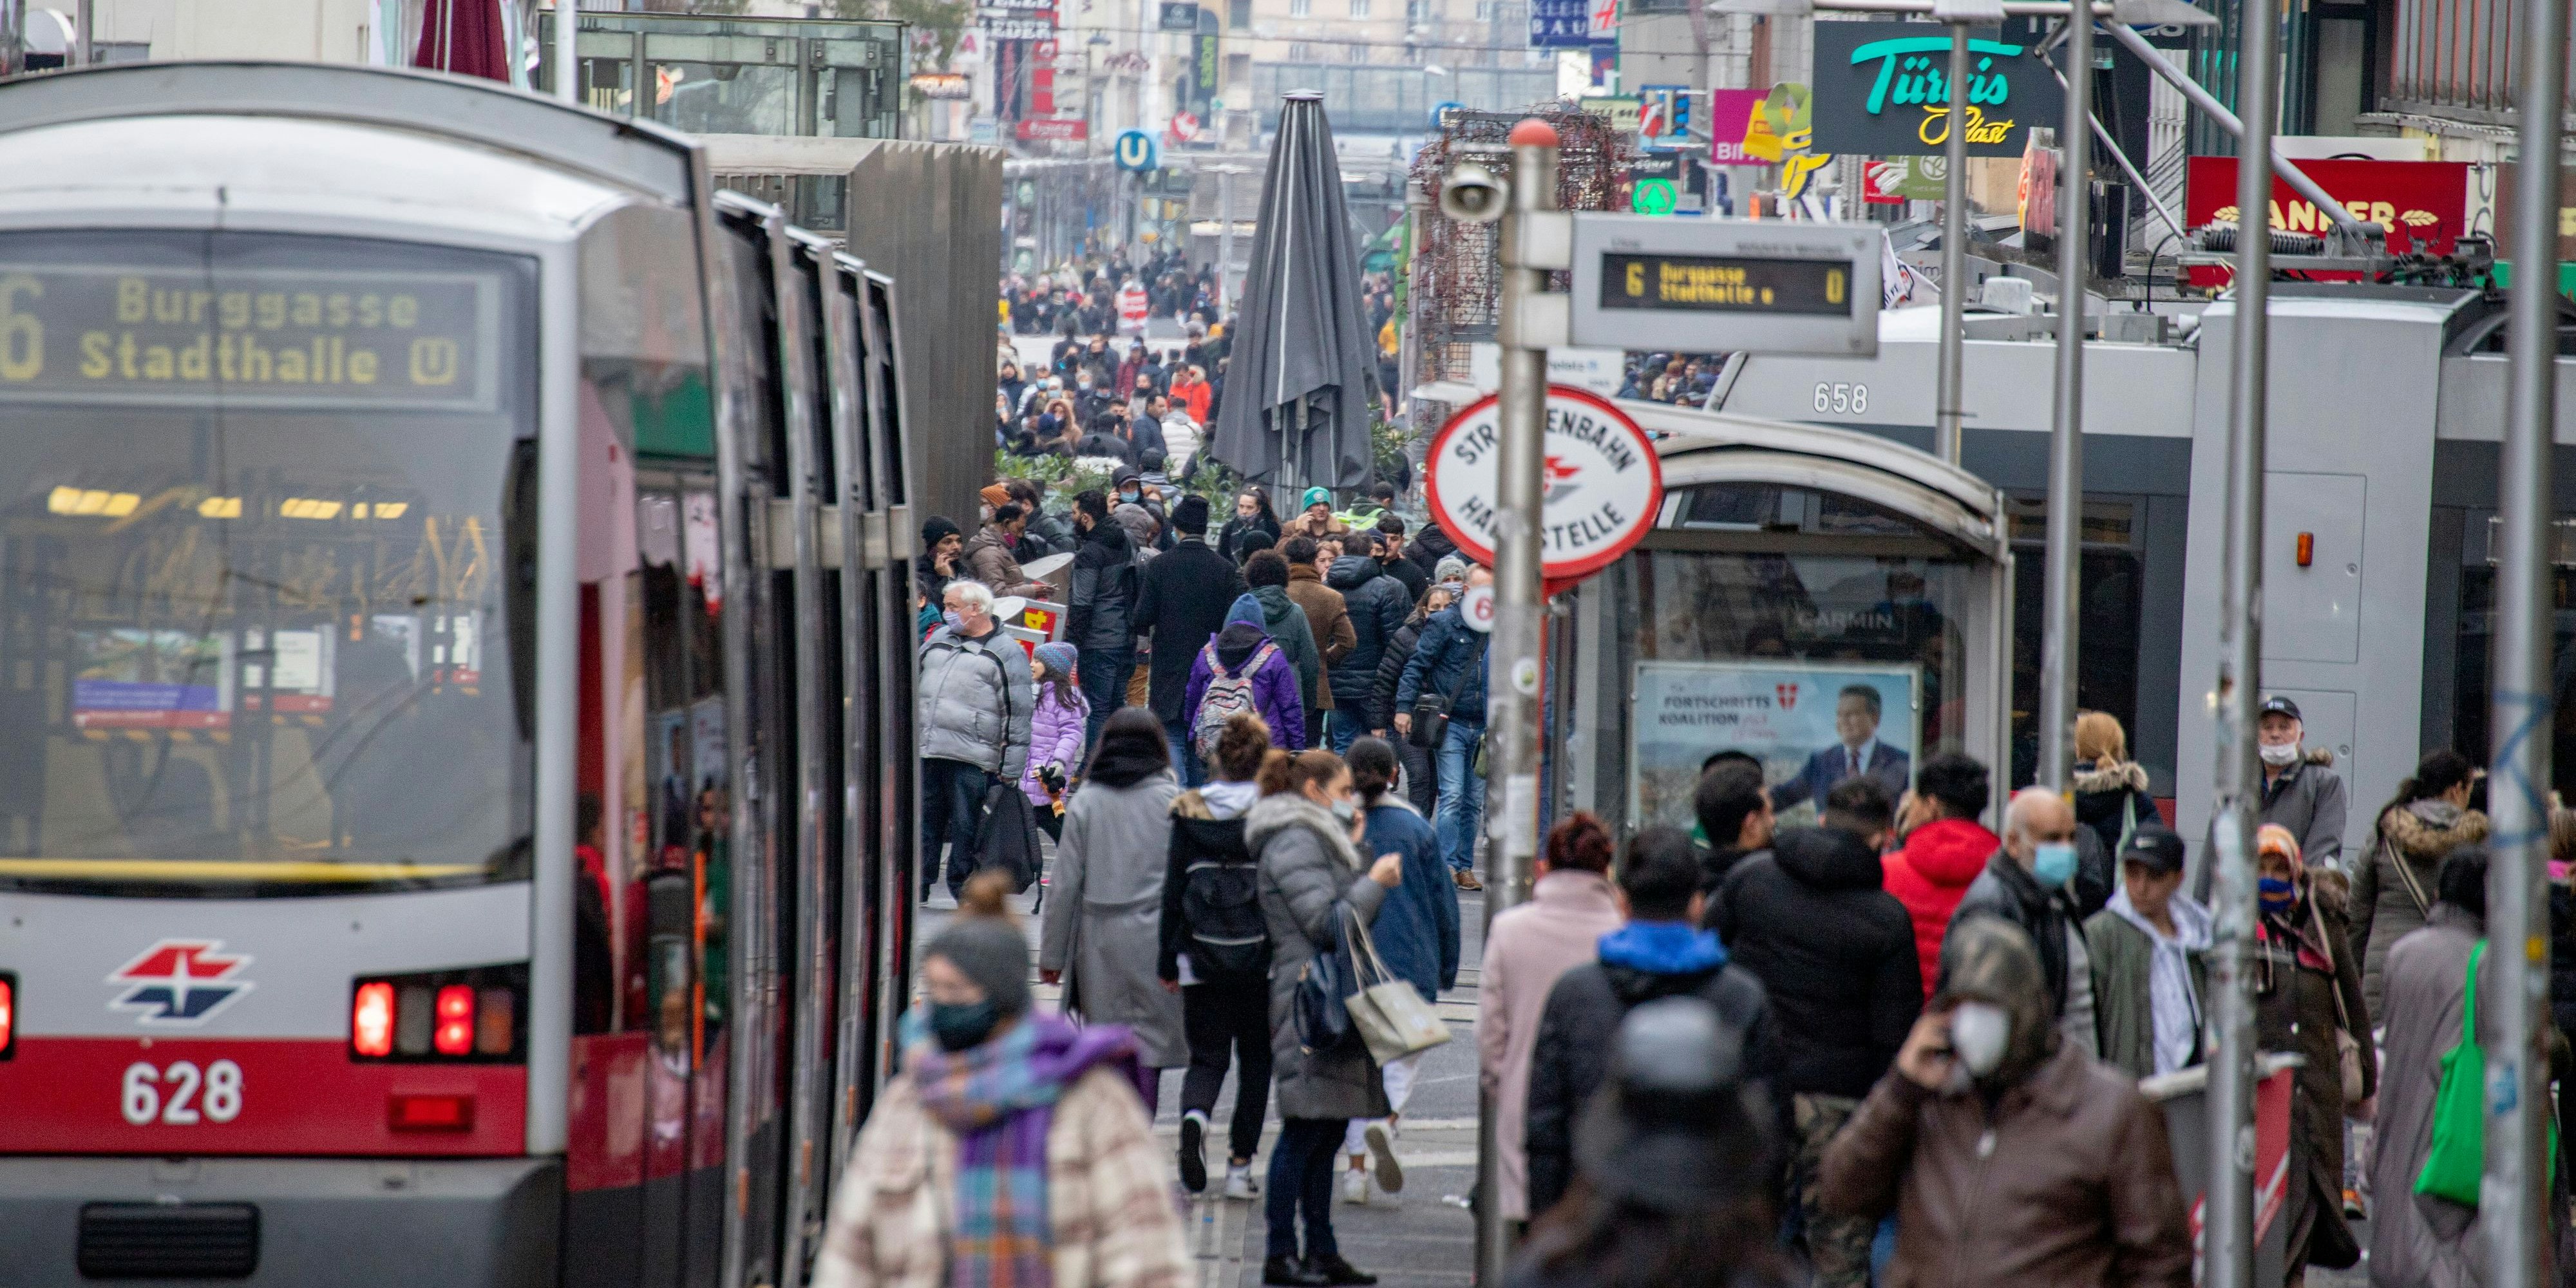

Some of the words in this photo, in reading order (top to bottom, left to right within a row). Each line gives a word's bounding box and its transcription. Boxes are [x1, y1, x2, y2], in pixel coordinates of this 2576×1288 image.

[1851, 37, 2023, 115] Türis
[1121, 137, 1149, 166] U
[1626, 262, 1645, 297] 6
[0, 275, 44, 382] 6
[117, 276, 418, 329] Burggasse
[79, 330, 379, 384] Stadthalle
[1812, 382, 1870, 415] 658
[1454, 408, 1638, 474] STRENBAHN
[1474, 596, 1493, 621] 6
[1658, 712, 1739, 726] KOALITION
[1663, 695, 1771, 710] FORTSCHRITTS
[121, 1058, 245, 1125] 628
